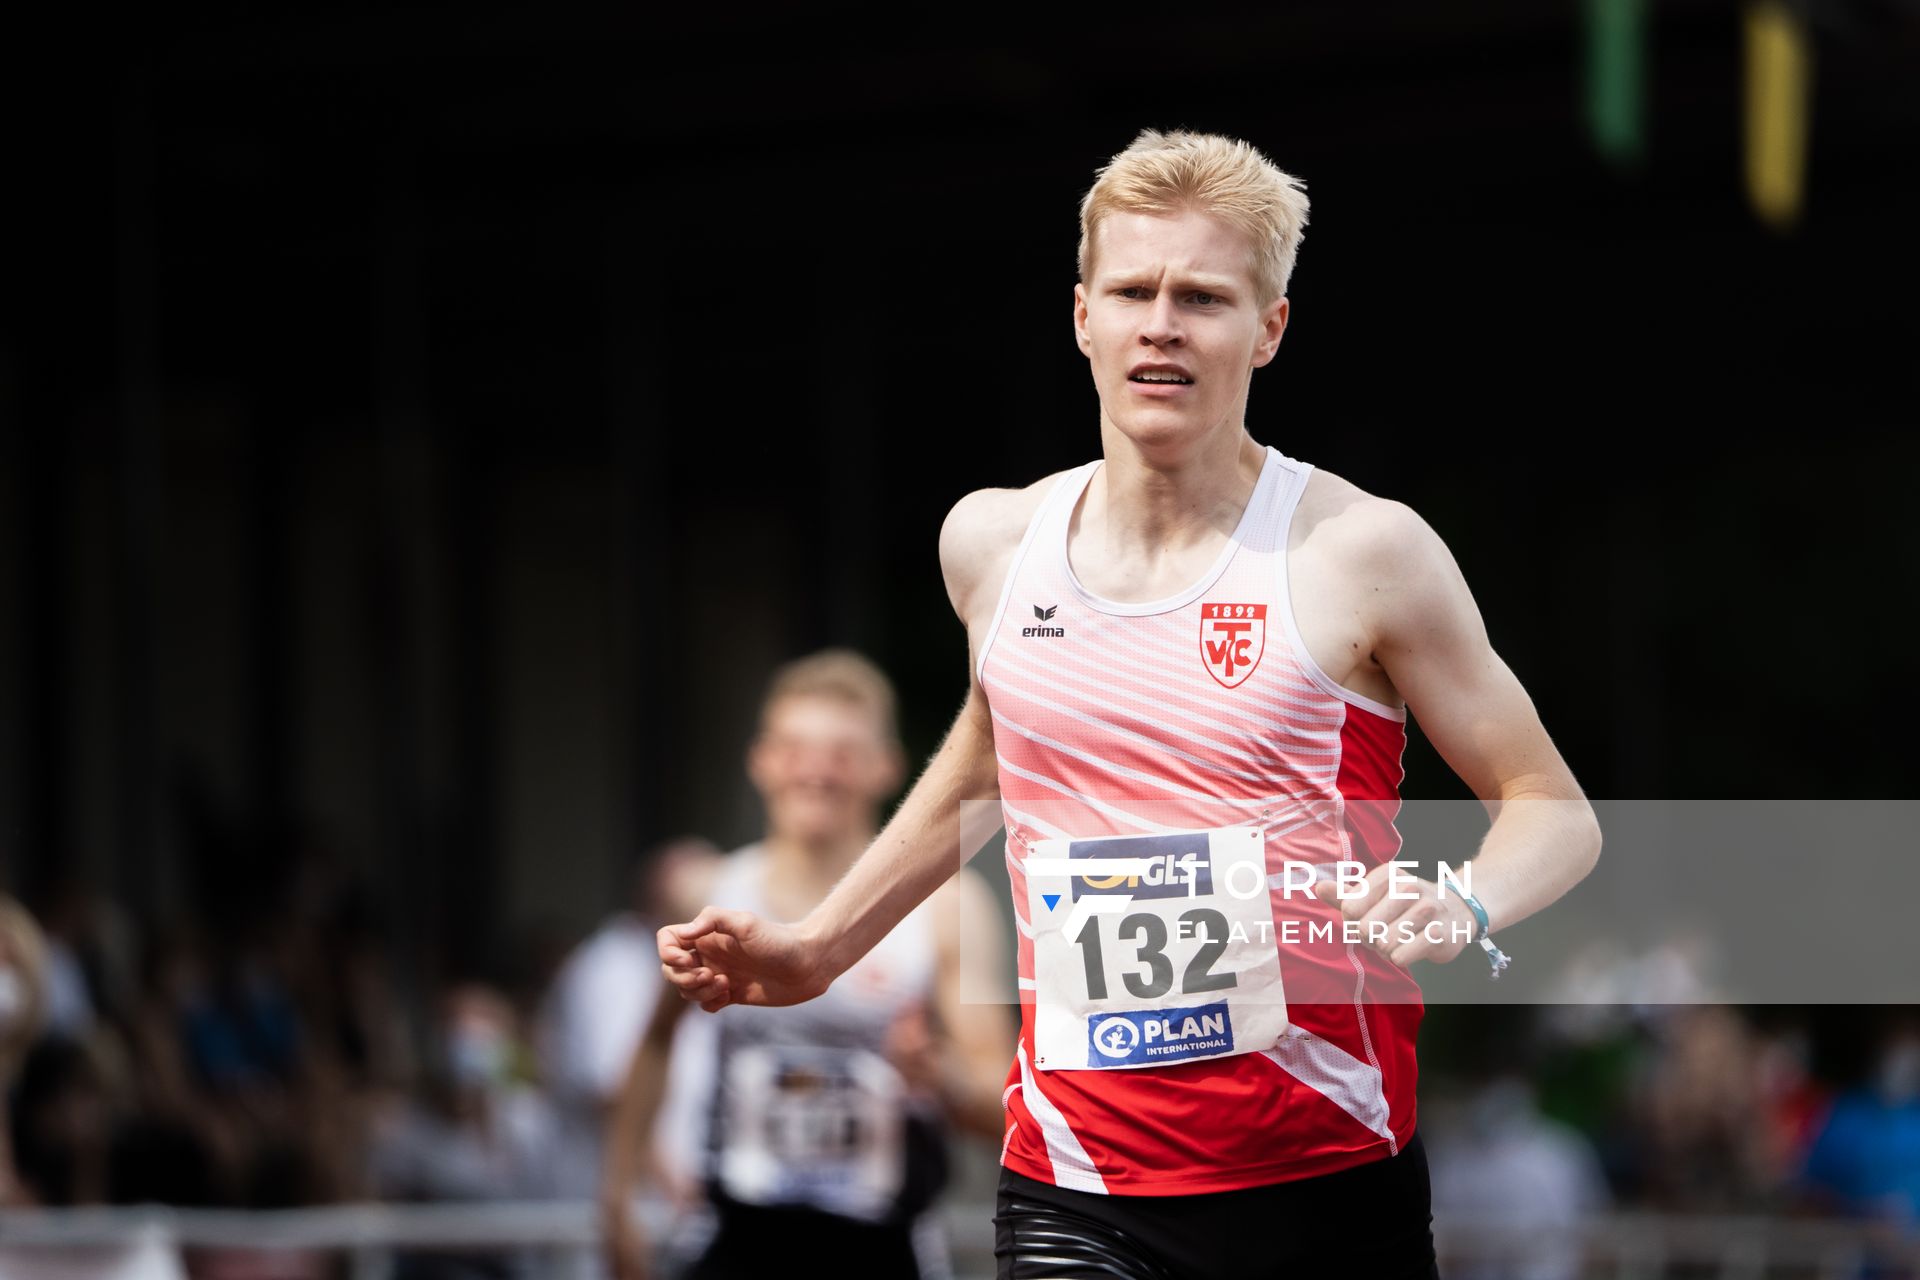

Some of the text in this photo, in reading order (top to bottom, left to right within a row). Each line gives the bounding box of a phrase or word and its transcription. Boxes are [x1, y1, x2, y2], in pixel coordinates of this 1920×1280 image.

[1022, 624, 1065, 638] erima
[1074, 907, 1238, 1001] 132
[1144, 1011, 1226, 1044] PLAN
[1146, 1038, 1227, 1056] INTERNATIONAL
